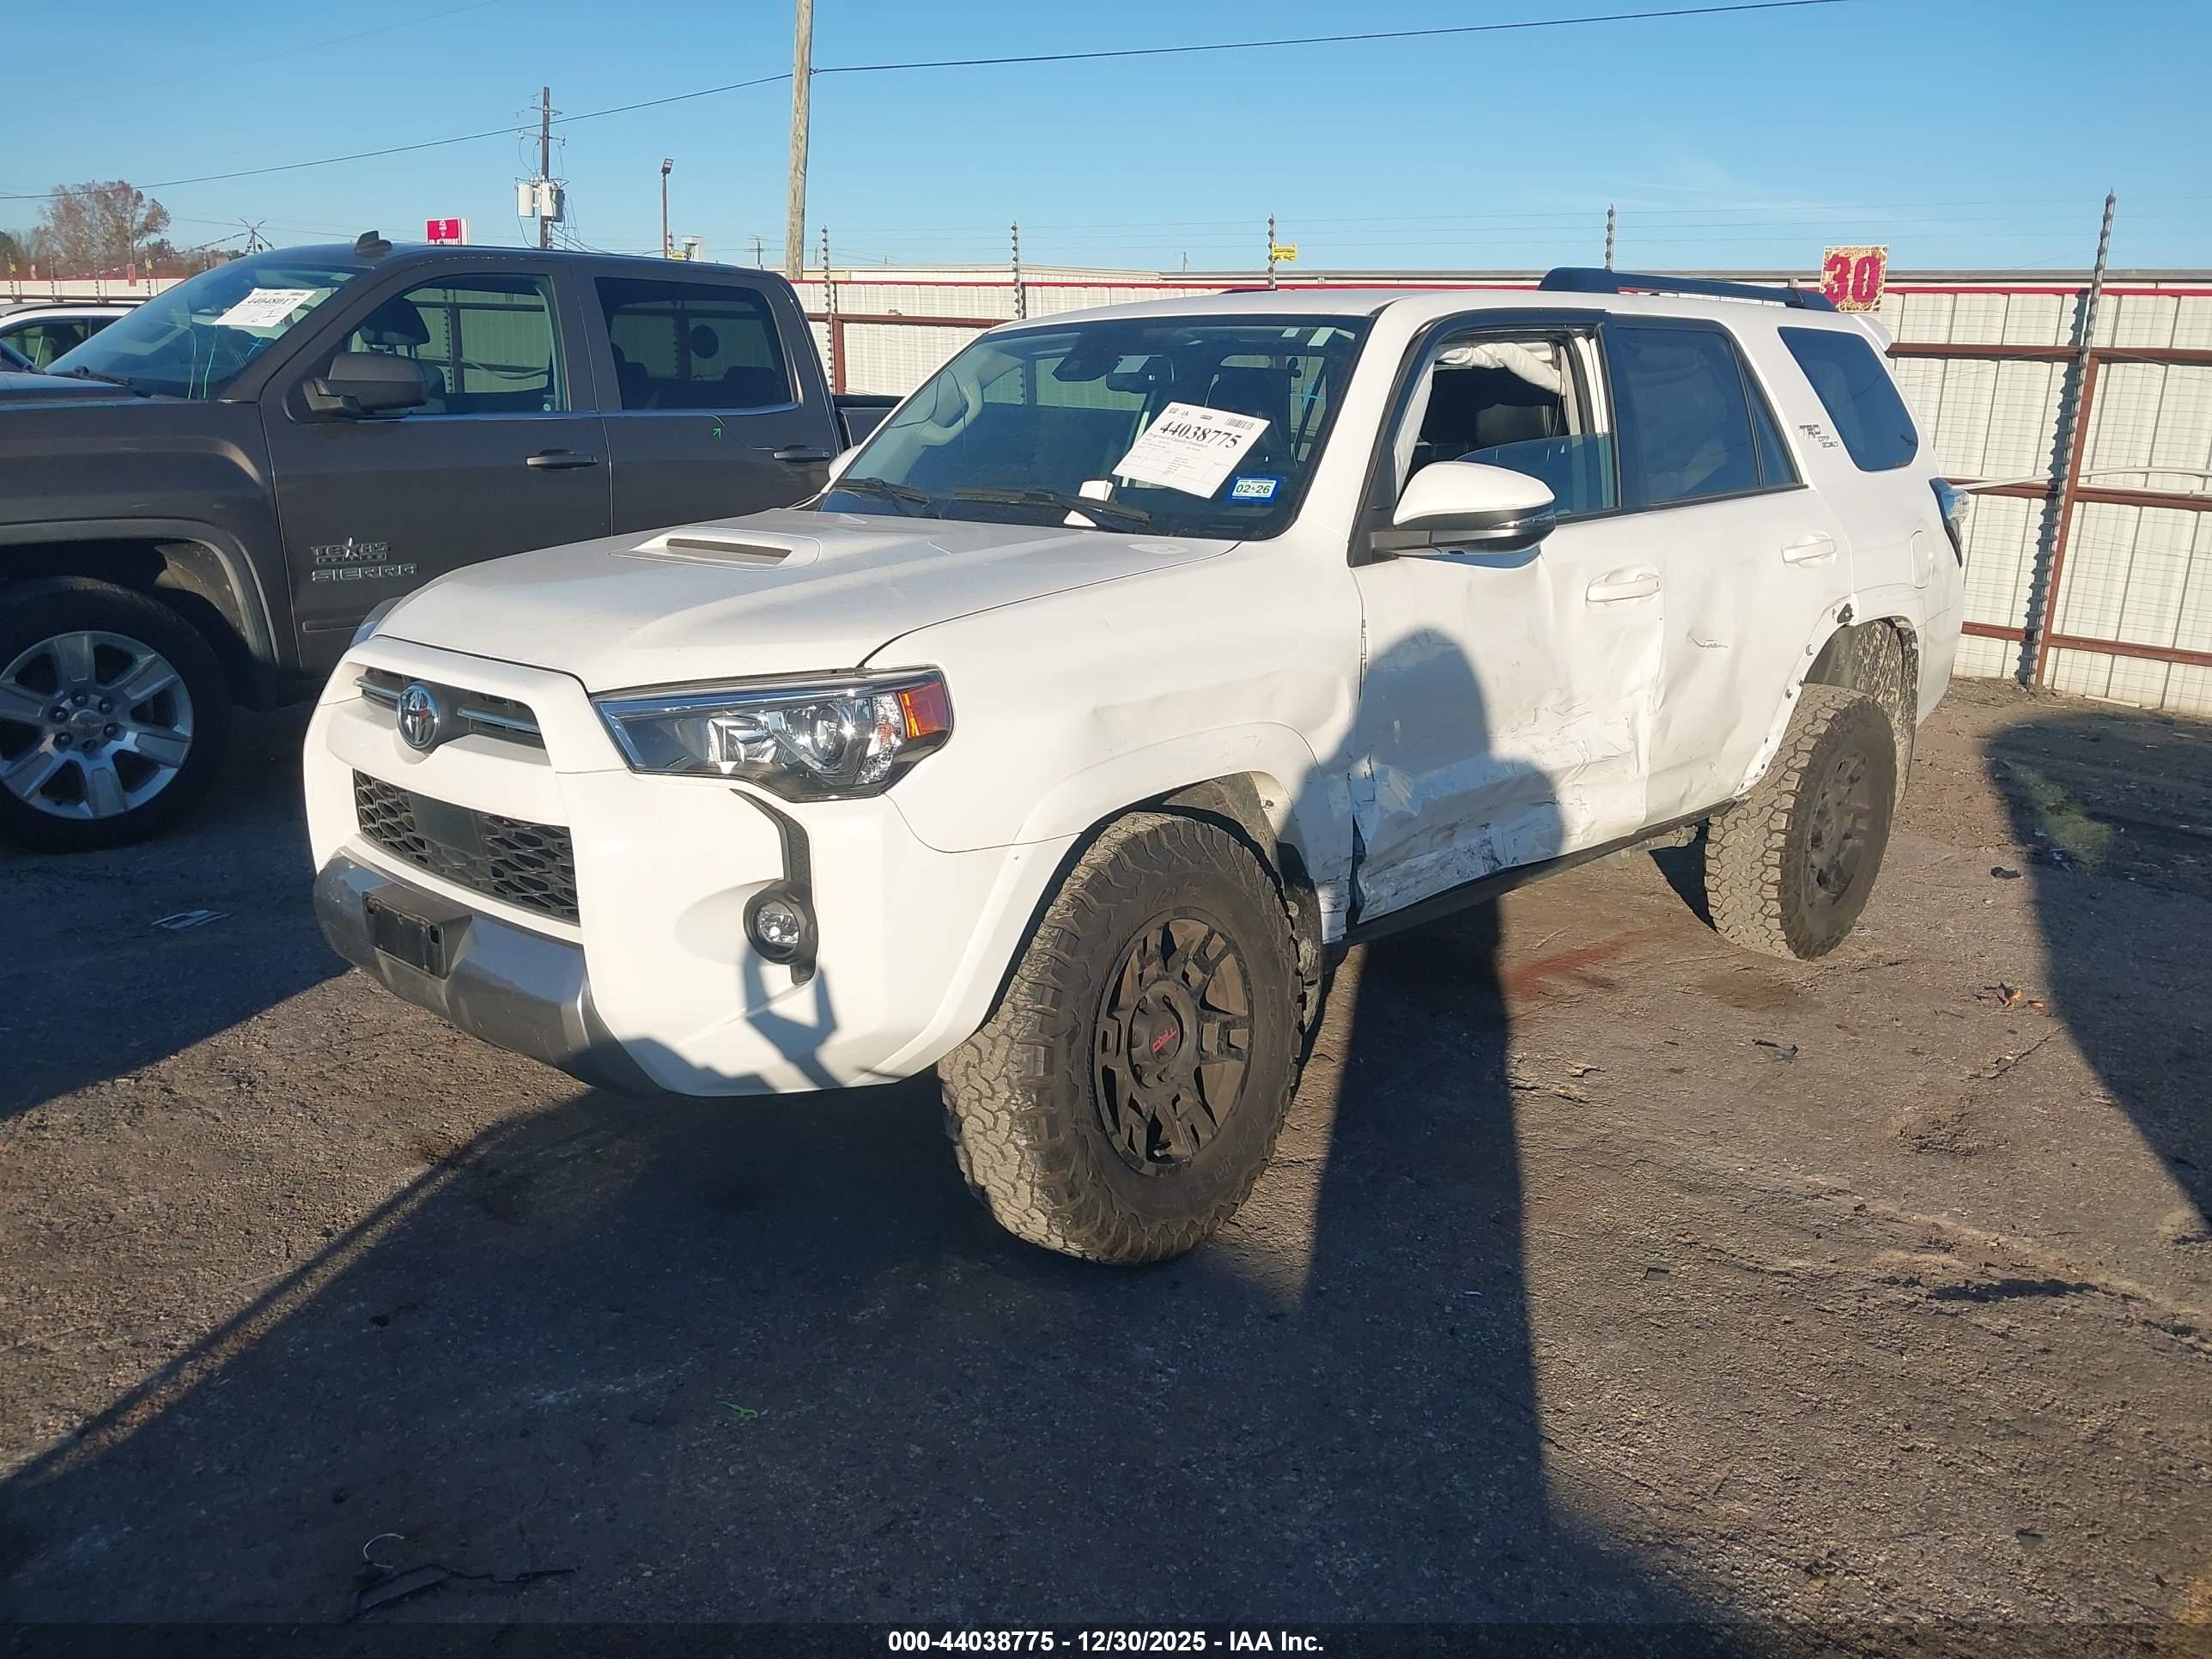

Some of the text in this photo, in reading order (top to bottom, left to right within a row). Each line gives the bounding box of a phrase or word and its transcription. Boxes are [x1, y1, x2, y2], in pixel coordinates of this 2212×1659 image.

[1824, 255, 1881, 303] 30
[1160, 420, 1243, 448] 44038775
[1798, 423, 1821, 440] TRD
[310, 538, 391, 559] TEXAS
[312, 563, 418, 581] SIERRA
